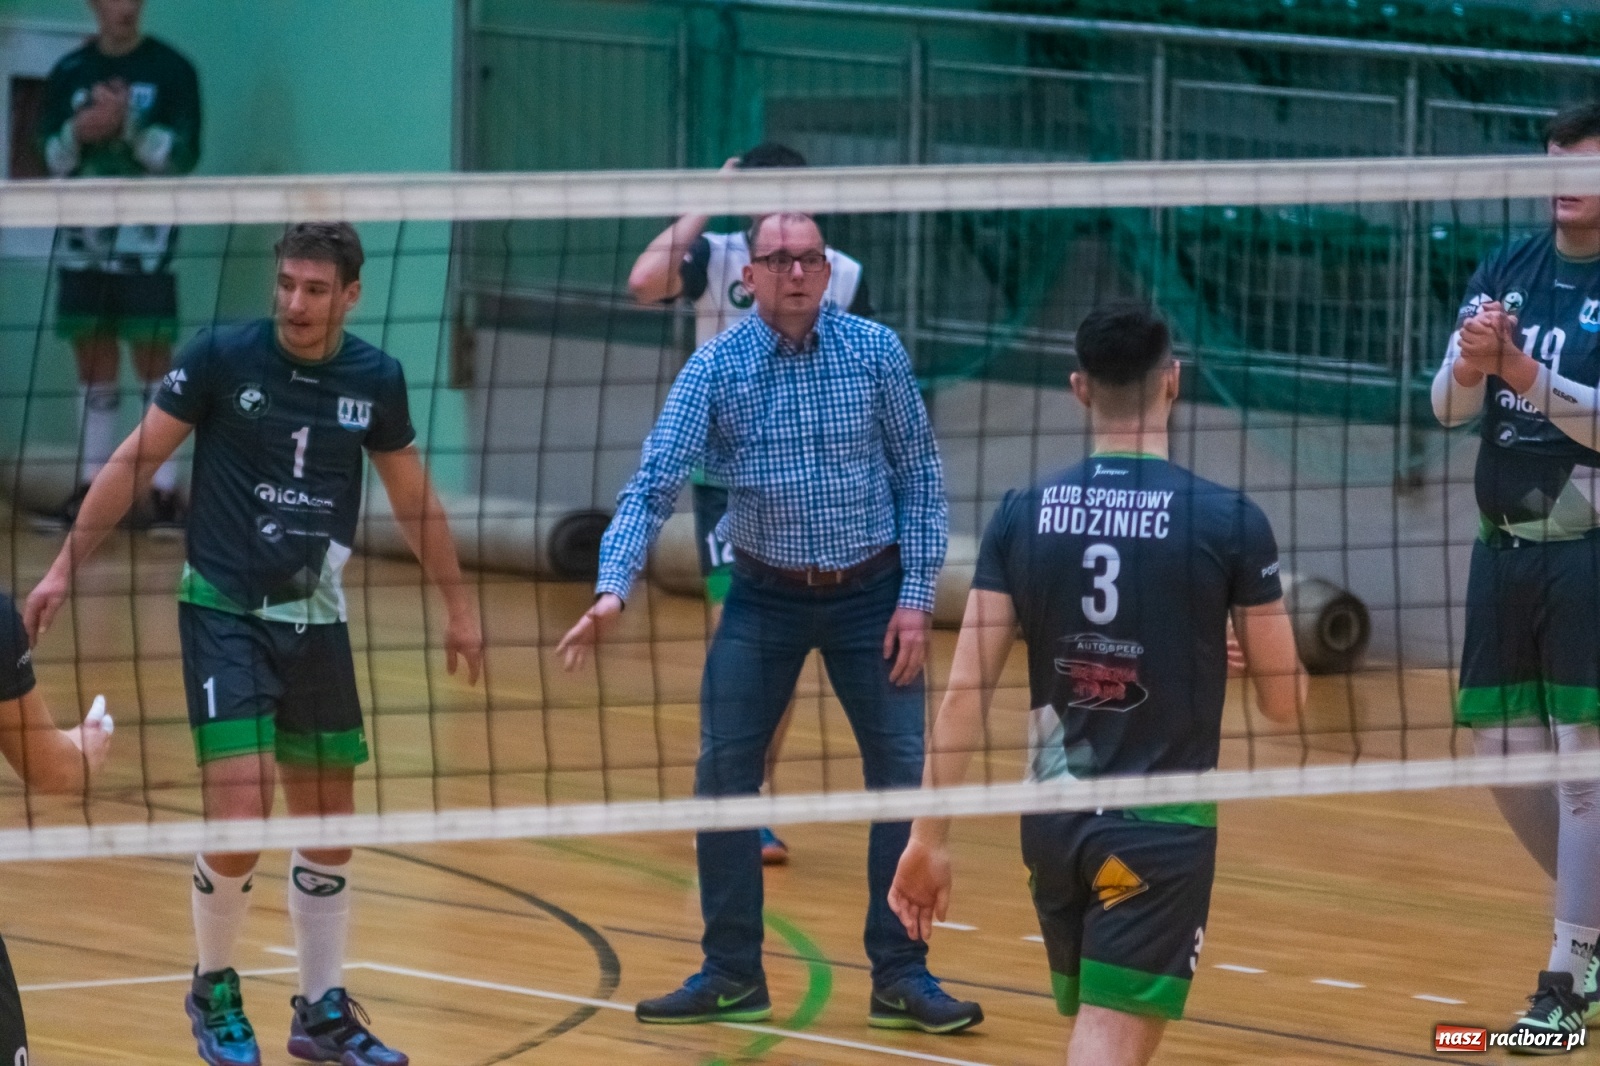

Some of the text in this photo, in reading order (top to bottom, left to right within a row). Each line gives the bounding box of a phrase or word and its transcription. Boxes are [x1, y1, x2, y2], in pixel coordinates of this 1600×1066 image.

[1521, 324, 1566, 375] 19
[291, 427, 310, 479] 1
[1041, 484, 1174, 509] KLUB SPORTOWY
[1038, 506, 1170, 539] RUDZINIEC
[1081, 543, 1121, 625] 3
[203, 677, 217, 718] 1
